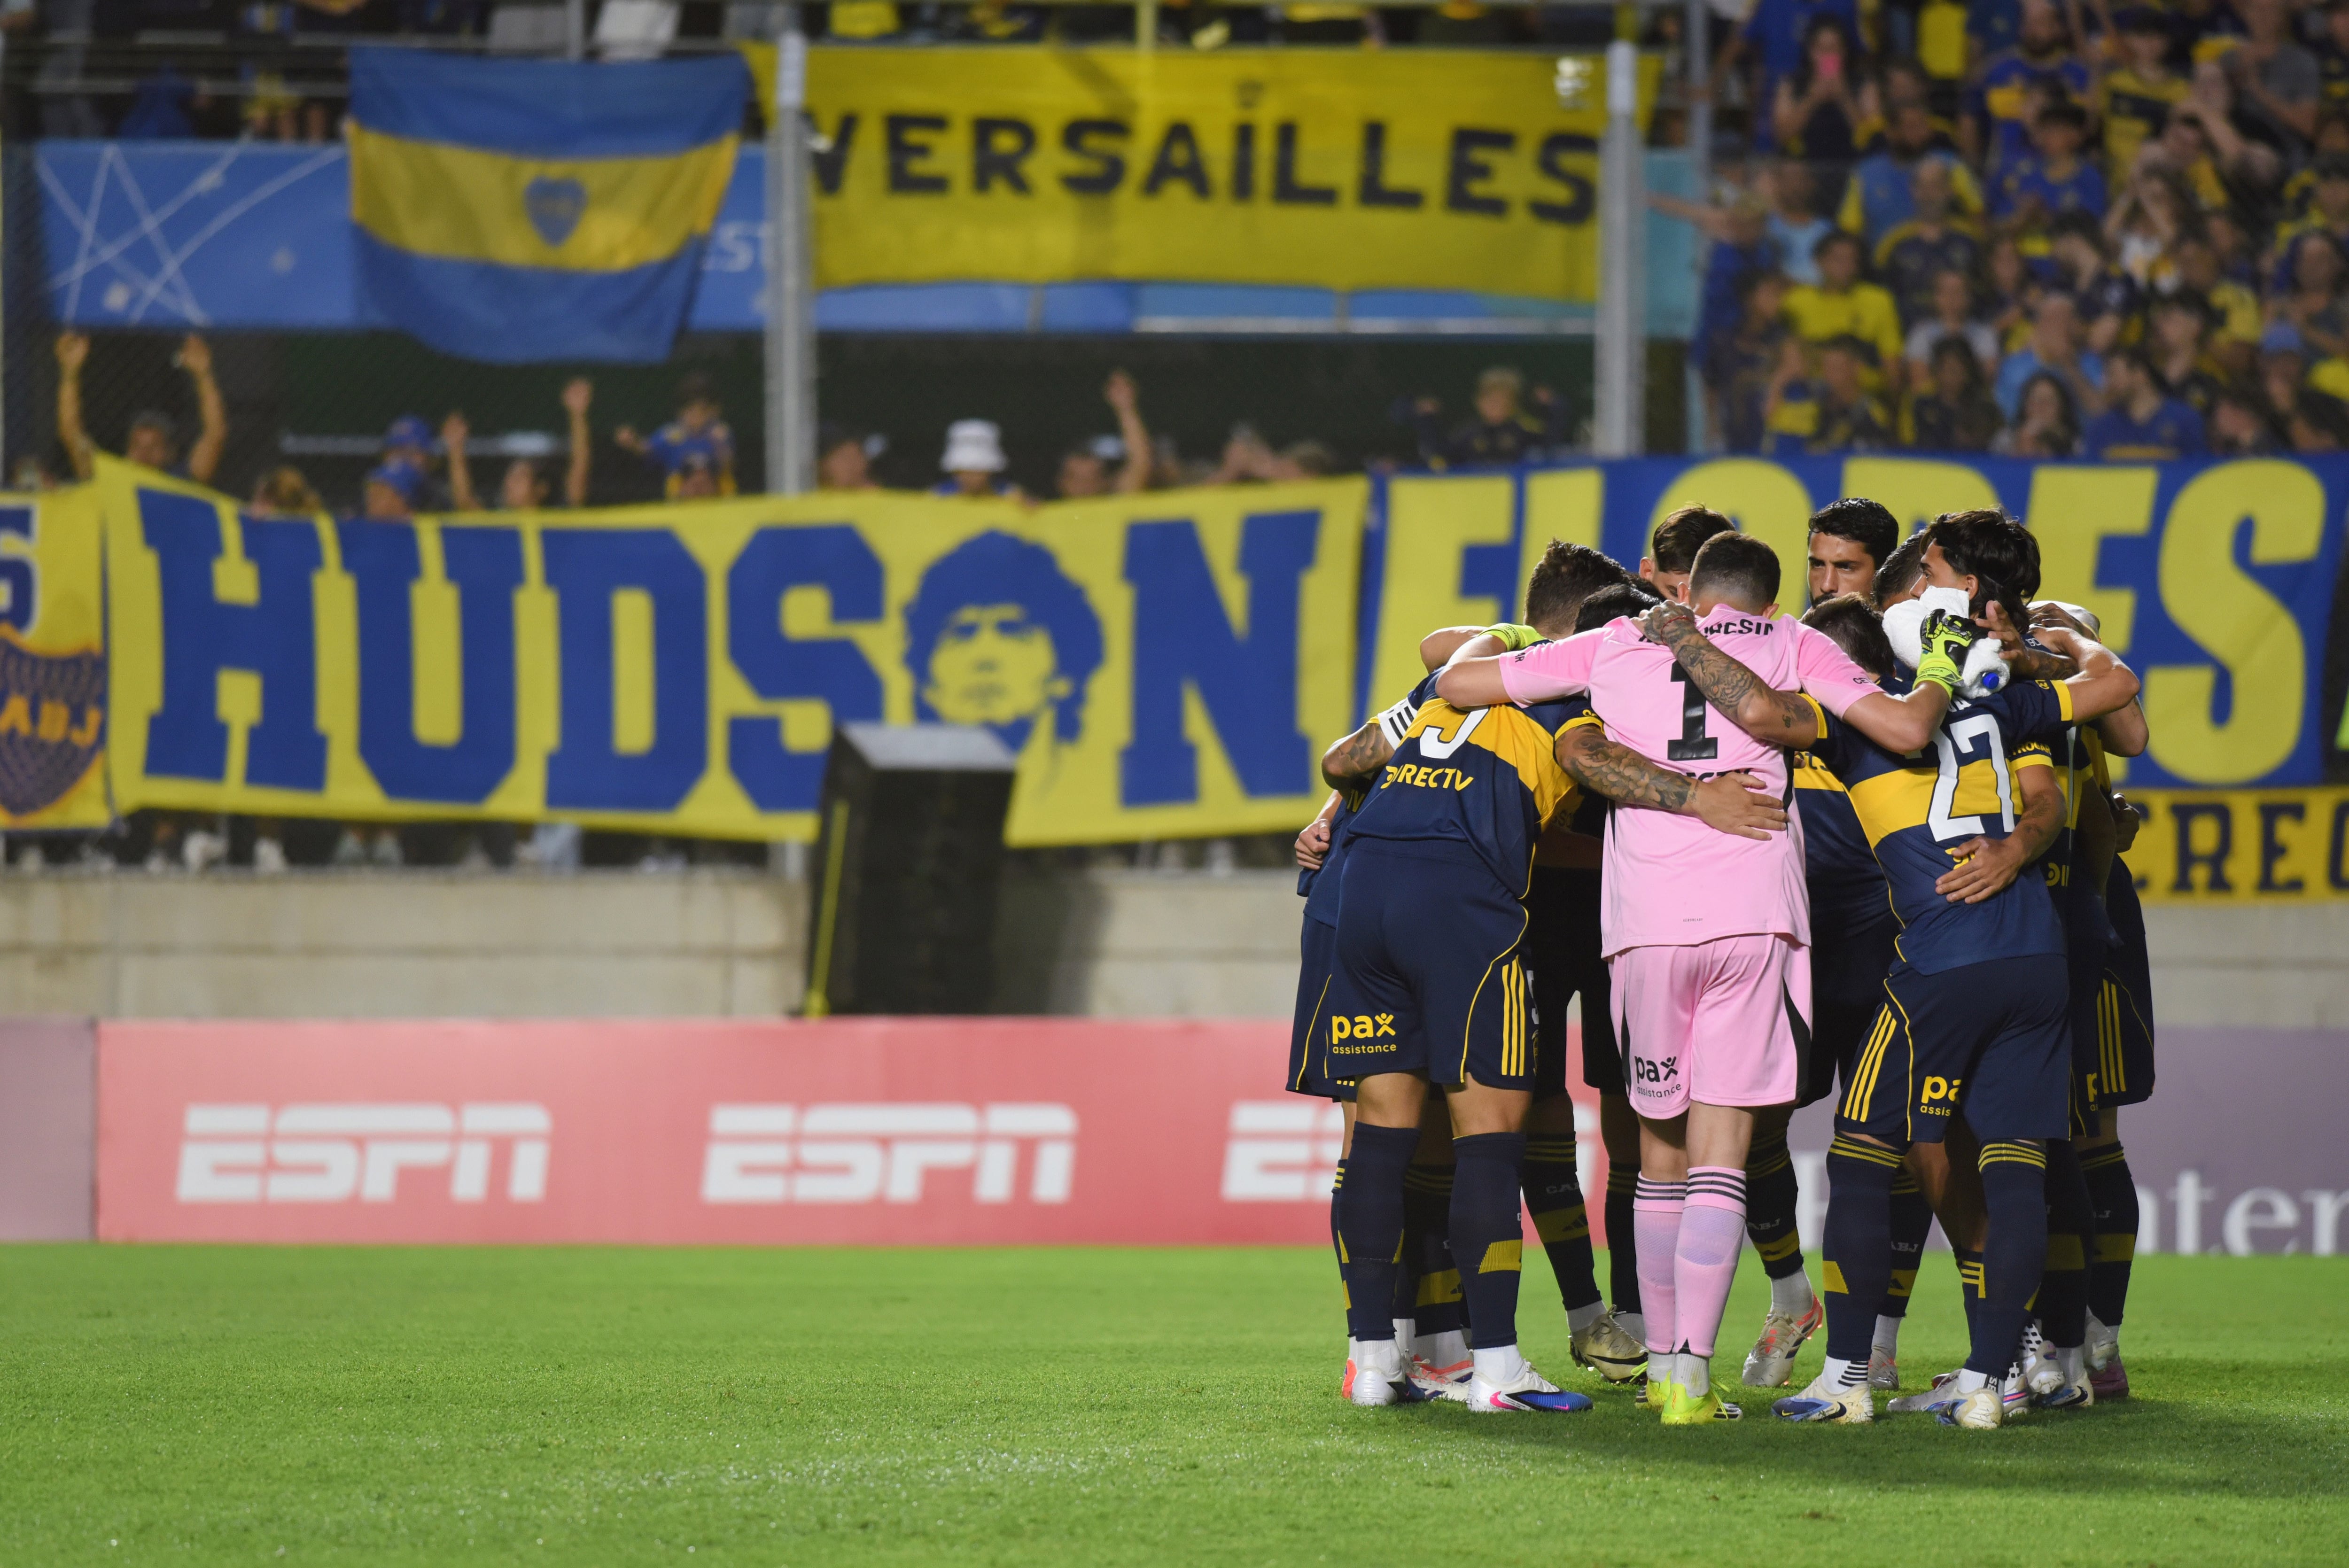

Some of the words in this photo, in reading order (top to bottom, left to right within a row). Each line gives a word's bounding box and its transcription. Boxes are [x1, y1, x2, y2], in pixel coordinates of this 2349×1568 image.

[797, 112, 1598, 226] VERSAILLES
[1365, 458, 2326, 785] FES
[1667, 659, 1718, 761] 1
[1905, 714, 2016, 842] 27
[1332, 1013, 1396, 1044] pax
[1332, 1044, 1397, 1054] assistance
[1634, 1056, 1678, 1084] pax
[1637, 1083, 1682, 1098] assistance
[177, 1102, 552, 1203] ESPN
[701, 1102, 1079, 1203] ESPN
